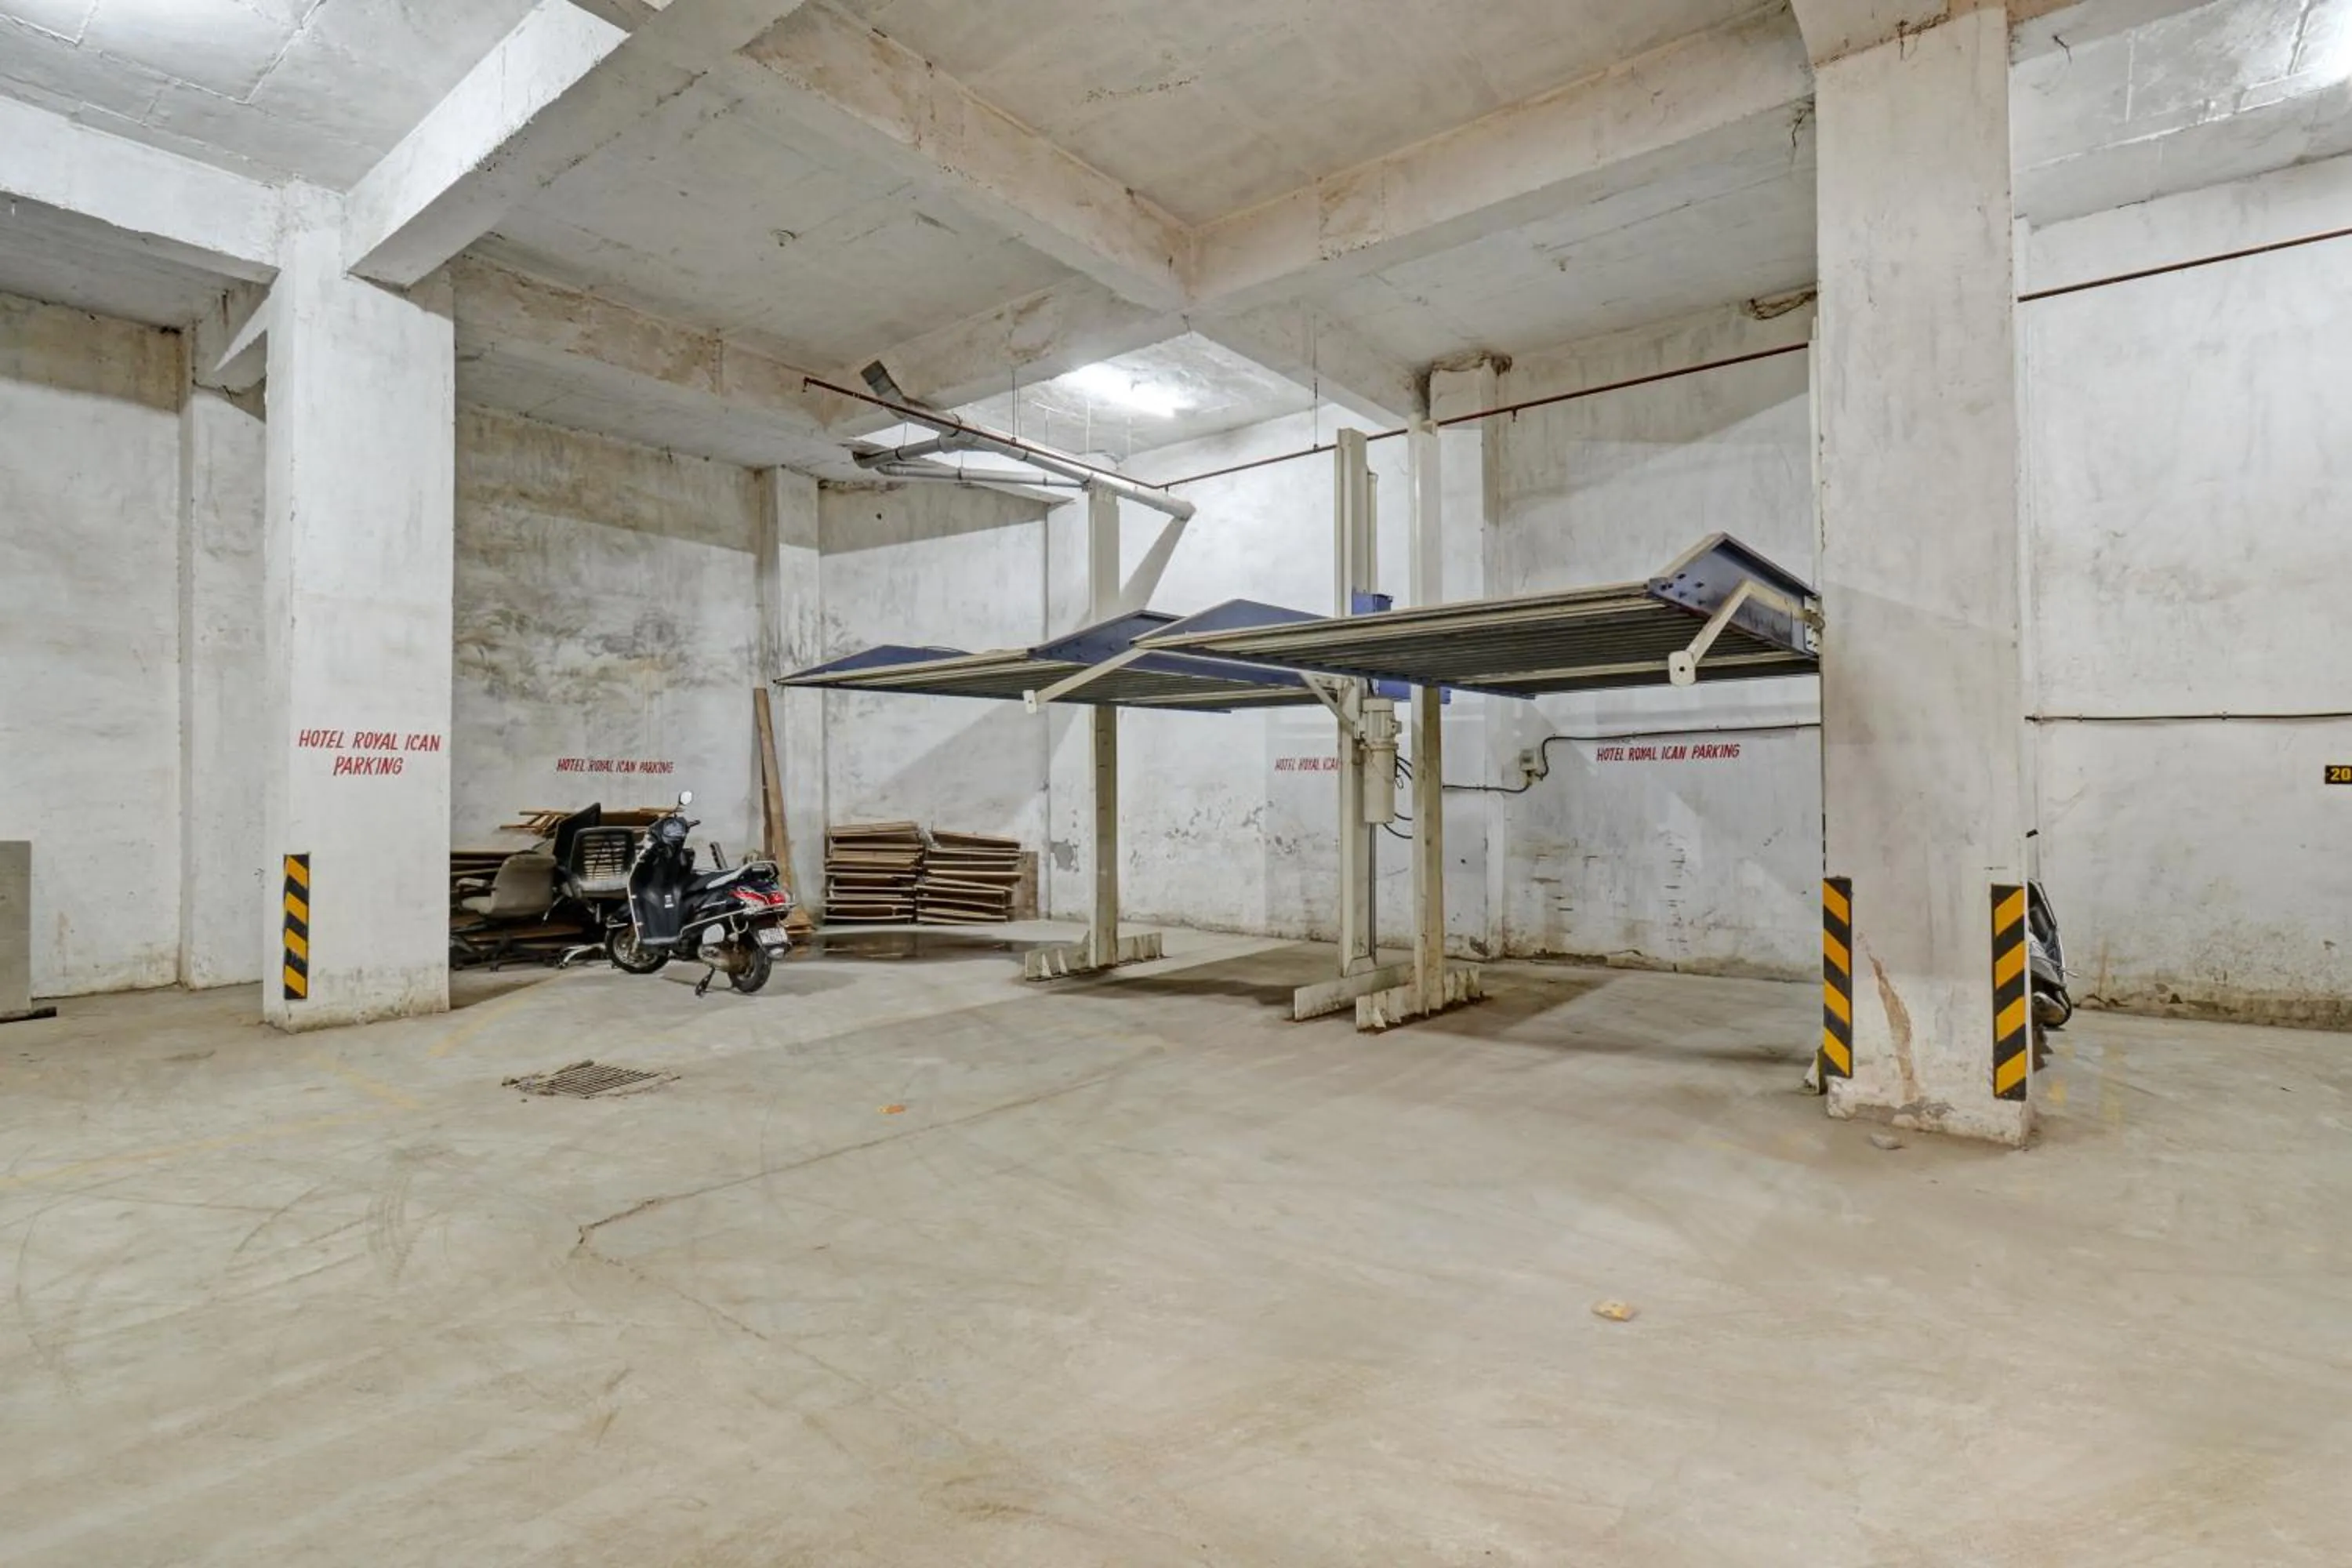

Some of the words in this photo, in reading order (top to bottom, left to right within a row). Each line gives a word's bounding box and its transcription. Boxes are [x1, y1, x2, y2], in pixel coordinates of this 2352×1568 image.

[299, 729, 344, 749] HOTEL
[352, 731, 398, 750] ROYAL
[404, 734, 441, 752] ICAN
[1596, 748, 1626, 761] HOTEL
[1628, 747, 1657, 760] ROYAL
[1661, 746, 1687, 760] ICAN
[1691, 744, 1741, 759] PARKING
[332, 756, 405, 776] PARKING
[557, 758, 585, 772] HOTEL
[588, 759, 614, 772] ROYAL
[639, 760, 674, 774] PARKING
